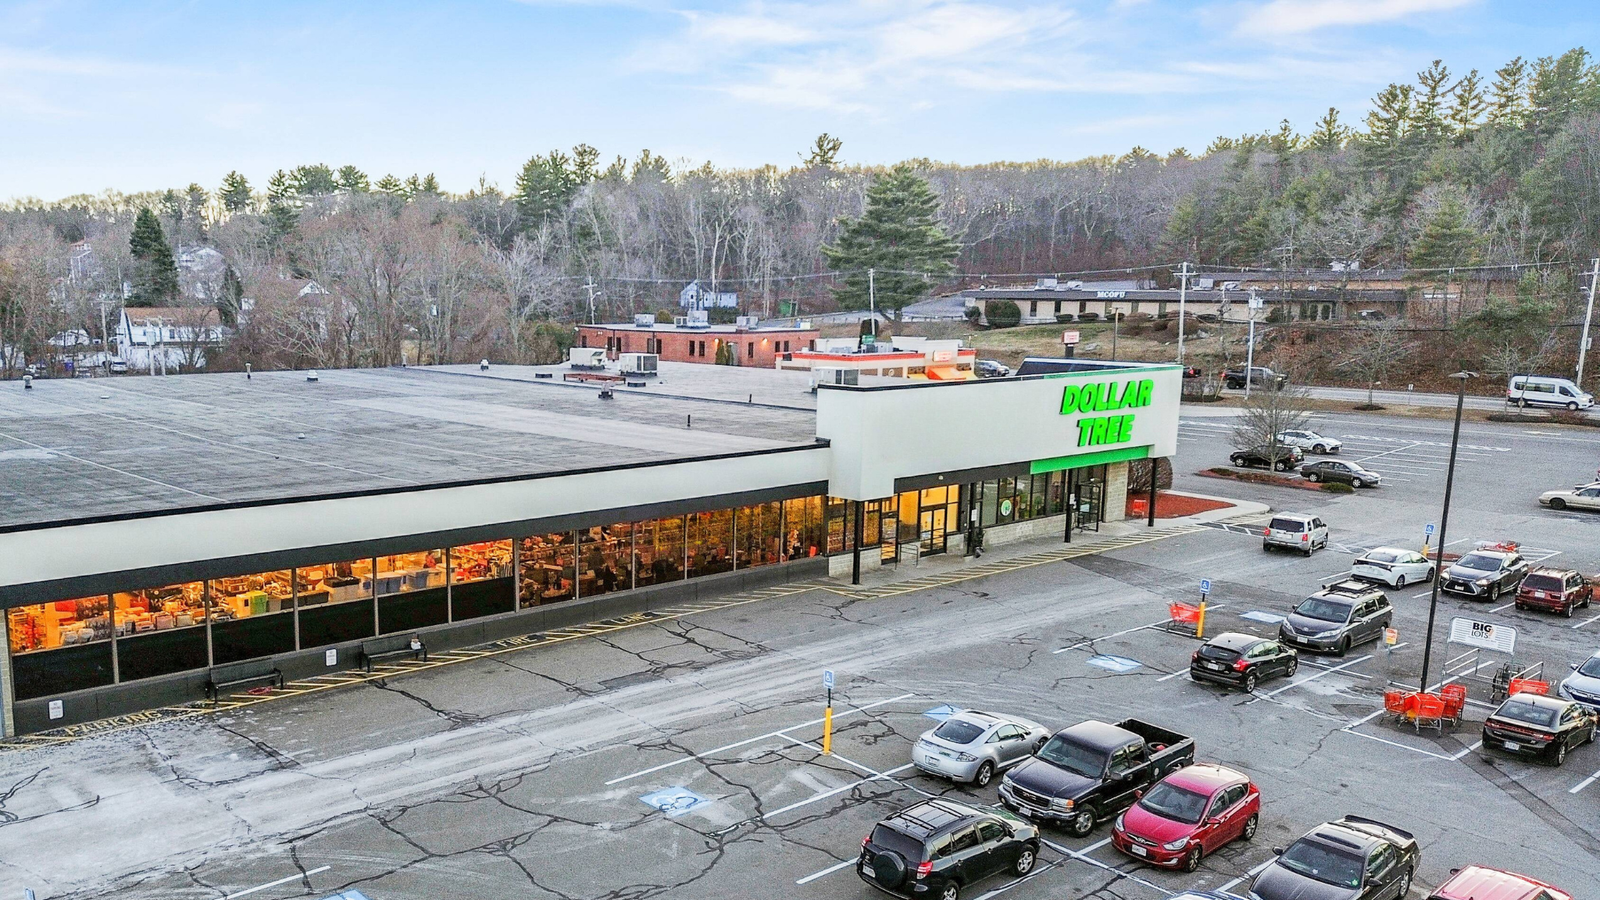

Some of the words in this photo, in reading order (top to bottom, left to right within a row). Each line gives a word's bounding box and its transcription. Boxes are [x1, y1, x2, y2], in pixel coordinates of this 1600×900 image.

[1059, 379, 1154, 415] DOLLAR
[1076, 414, 1135, 447] TREE
[496, 635, 538, 647] FIRE
[611, 612, 653, 624] LANE
[1471, 630, 1489, 638] LOTS
[1473, 622, 1492, 632] BIG
[64, 709, 162, 737] PARKING
